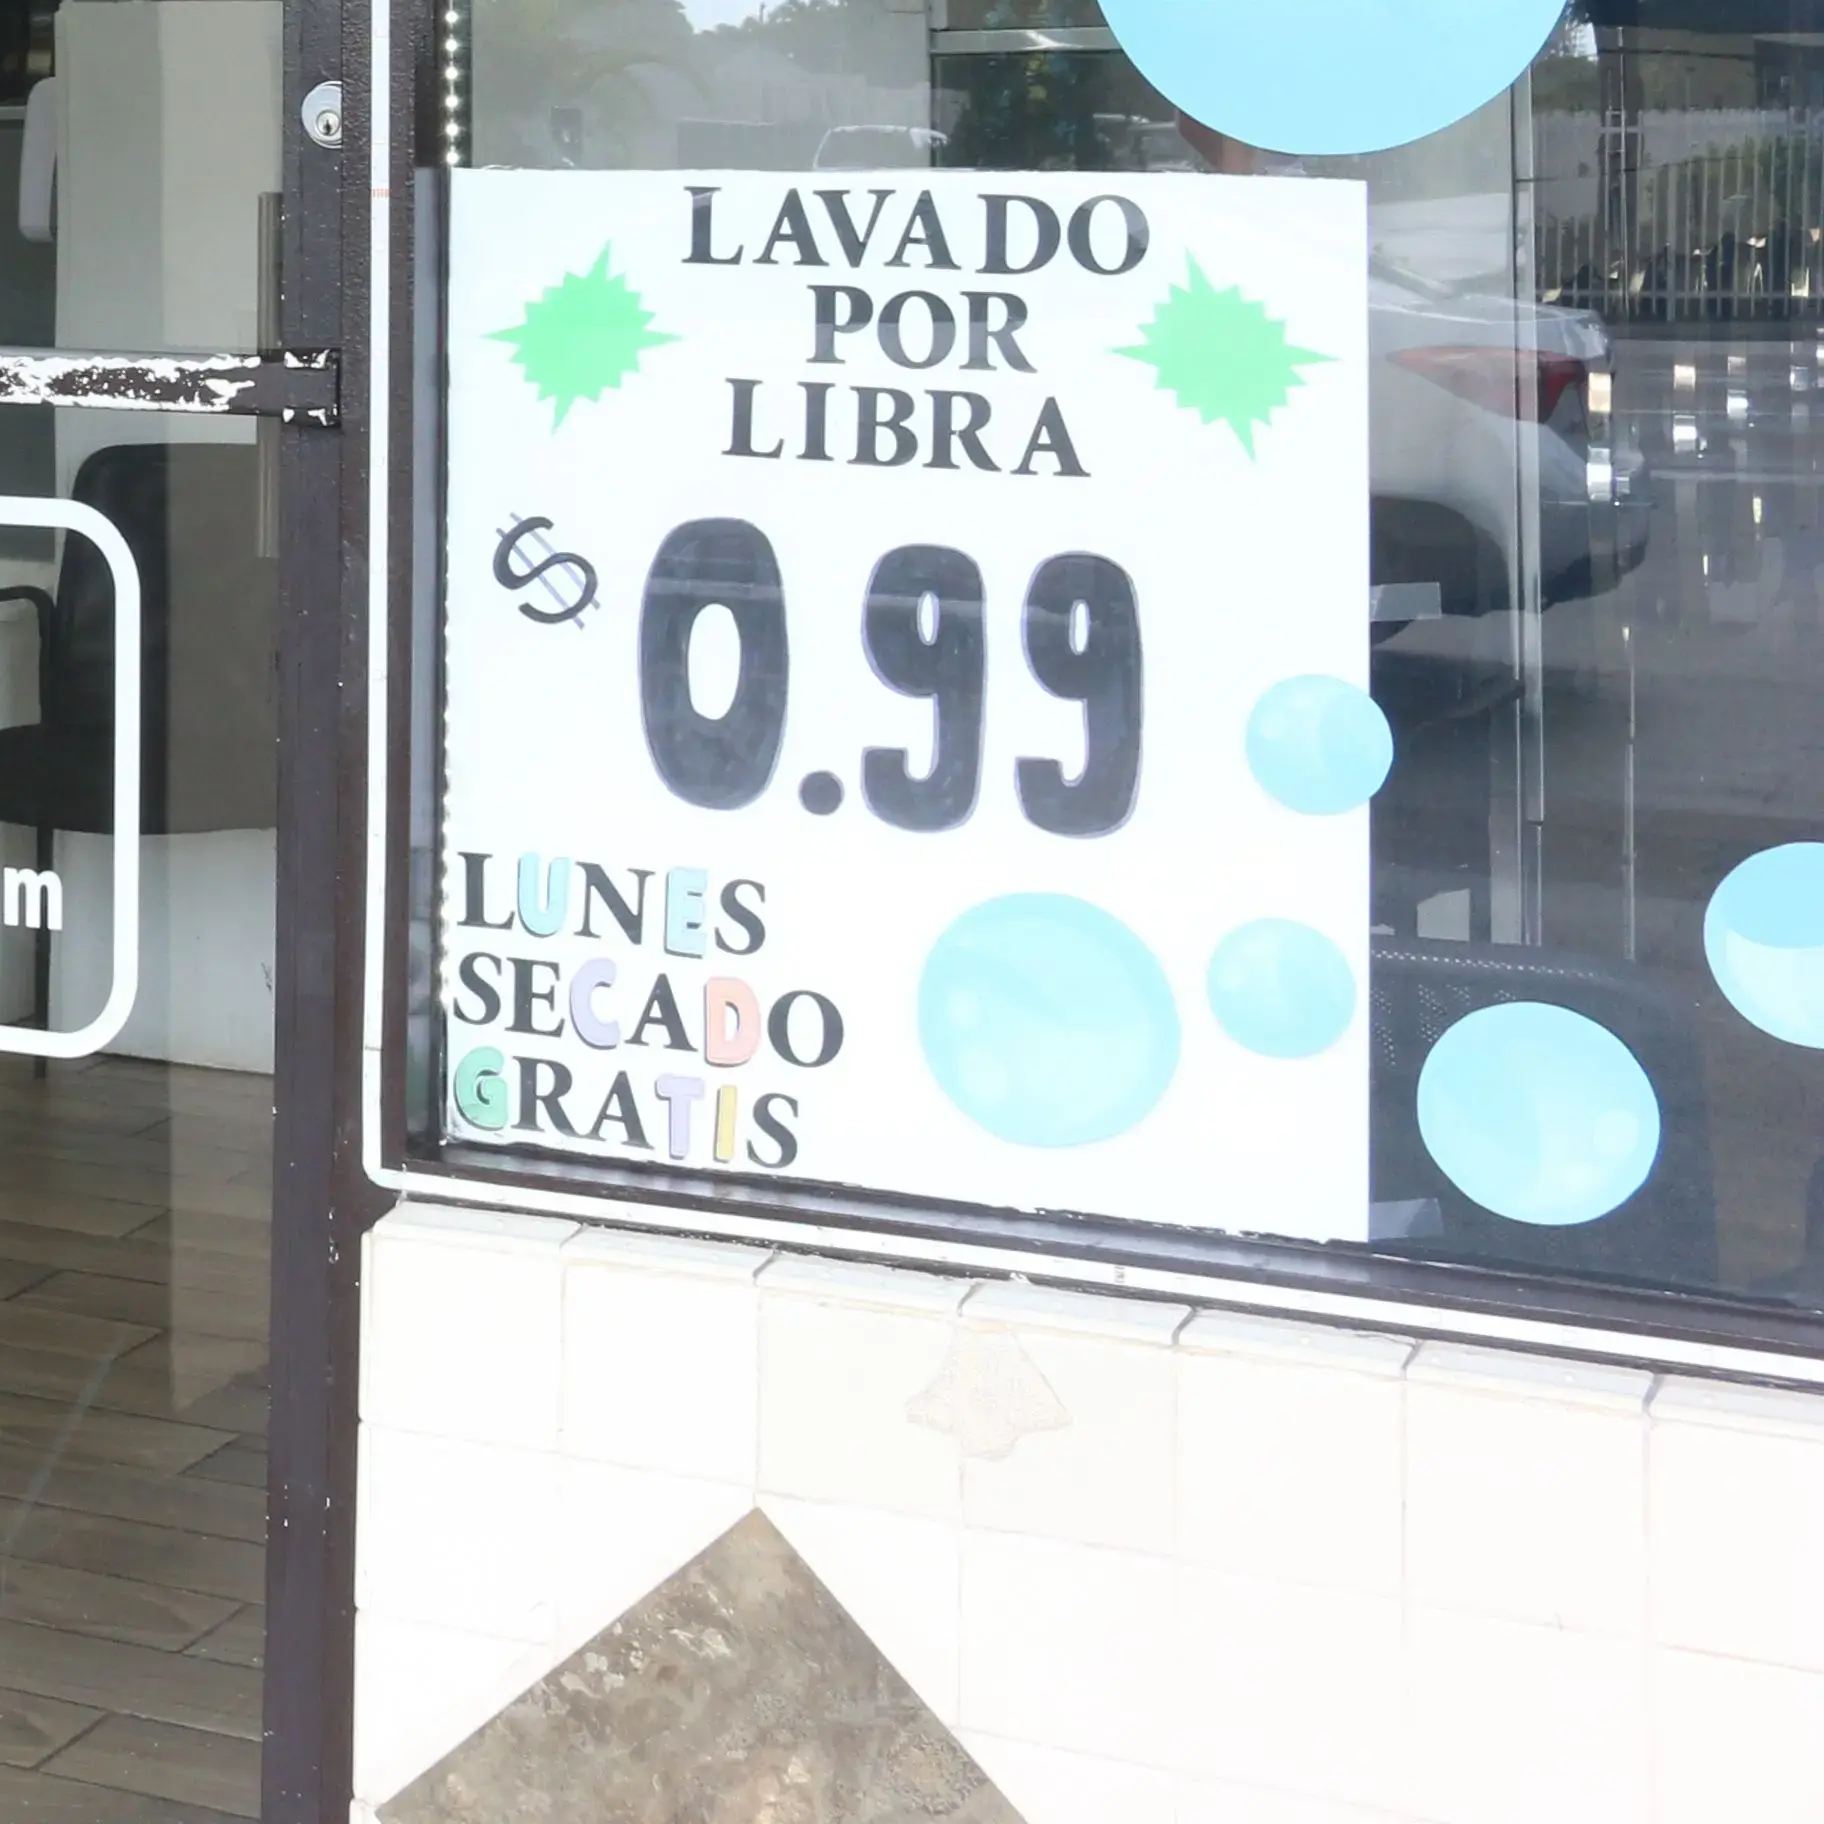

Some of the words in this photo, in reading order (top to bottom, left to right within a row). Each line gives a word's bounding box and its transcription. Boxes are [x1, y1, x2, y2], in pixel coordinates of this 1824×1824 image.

[681, 184, 1151, 276] LAVADO
[806, 283, 1038, 374] POR
[721, 376, 1091, 478] LIBRA
[492, 510, 602, 630] $
[637, 516, 1144, 840] 0.99
[456, 850, 768, 959] LUNES
[452, 951, 845, 1069] SECADO
[453, 1045, 801, 1170] GRATIS
